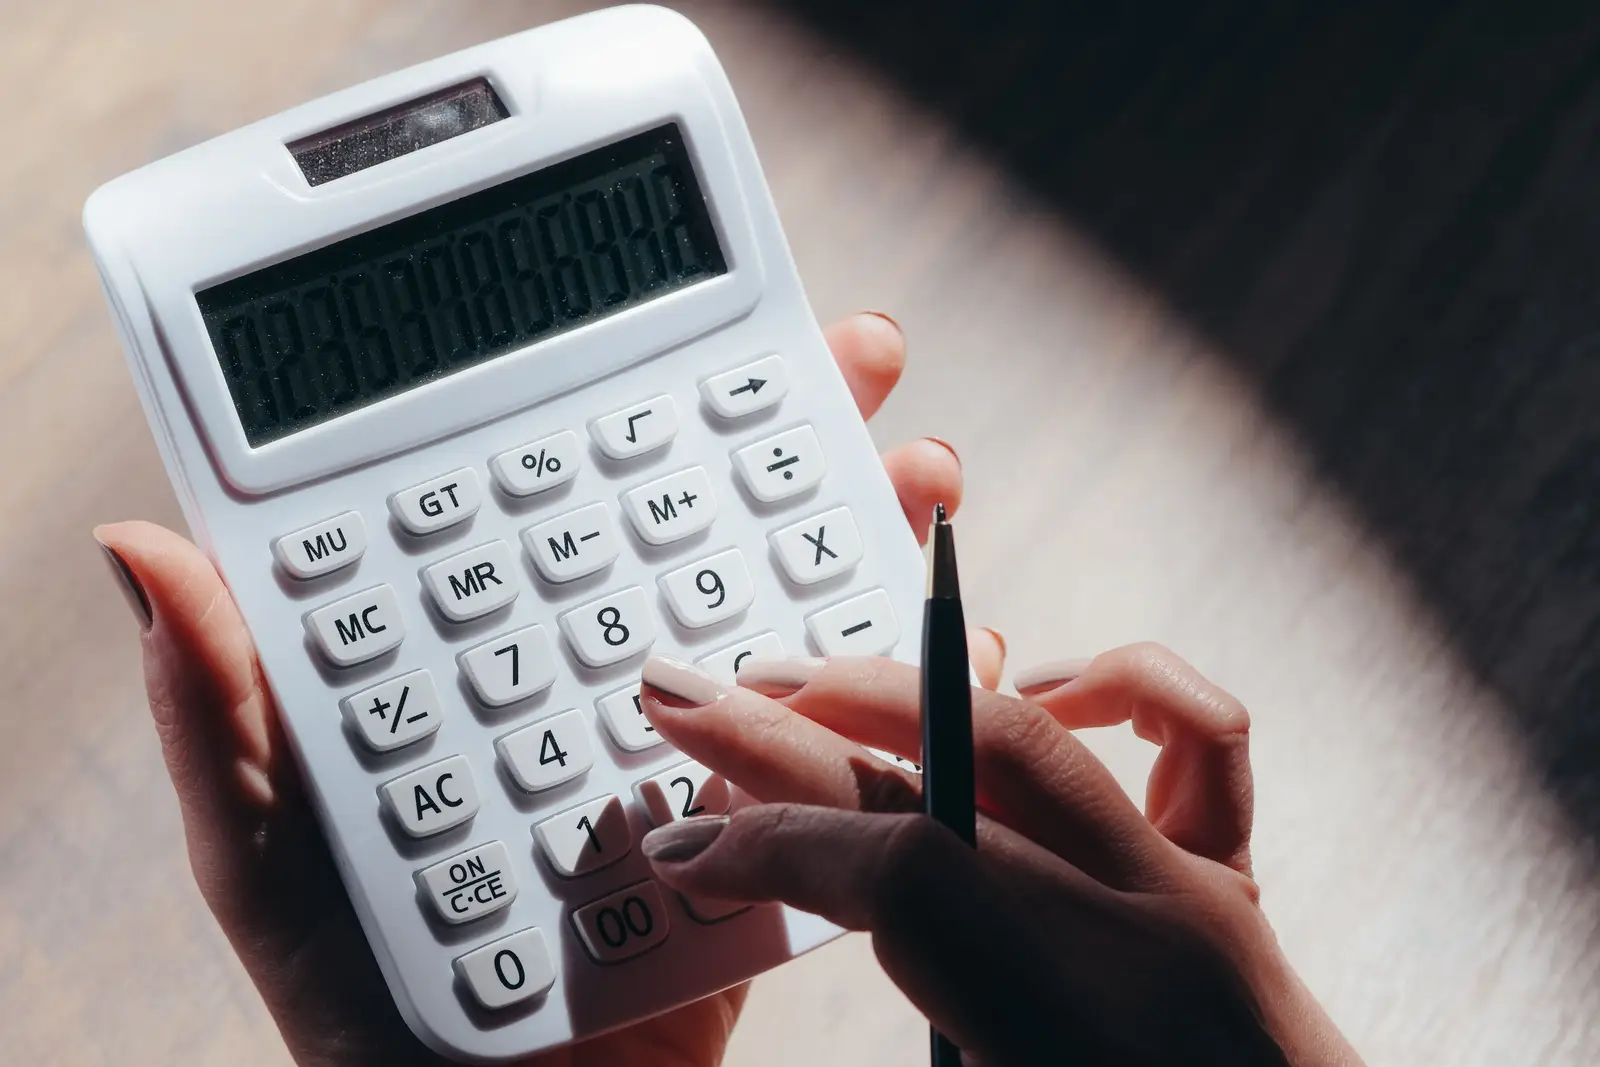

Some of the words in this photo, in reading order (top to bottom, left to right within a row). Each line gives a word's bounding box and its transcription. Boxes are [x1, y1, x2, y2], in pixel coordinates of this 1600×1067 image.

[522, 449, 561, 477] %
[420, 483, 459, 516] GT
[648, 492, 697, 524] M+
[303, 528, 346, 562] MU
[448, 562, 502, 600] MR
[696, 570, 724, 608] 9
[335, 605, 385, 644] MC
[597, 607, 629, 645] 8
[494, 644, 518, 686] 7
[540, 730, 567, 766] 4
[413, 773, 464, 822] AC
[668, 776, 706, 818] 2
[576, 815, 602, 854] 1
[449, 856, 485, 883] ON
[596, 896, 653, 947] 00
[493, 949, 526, 990] 0
